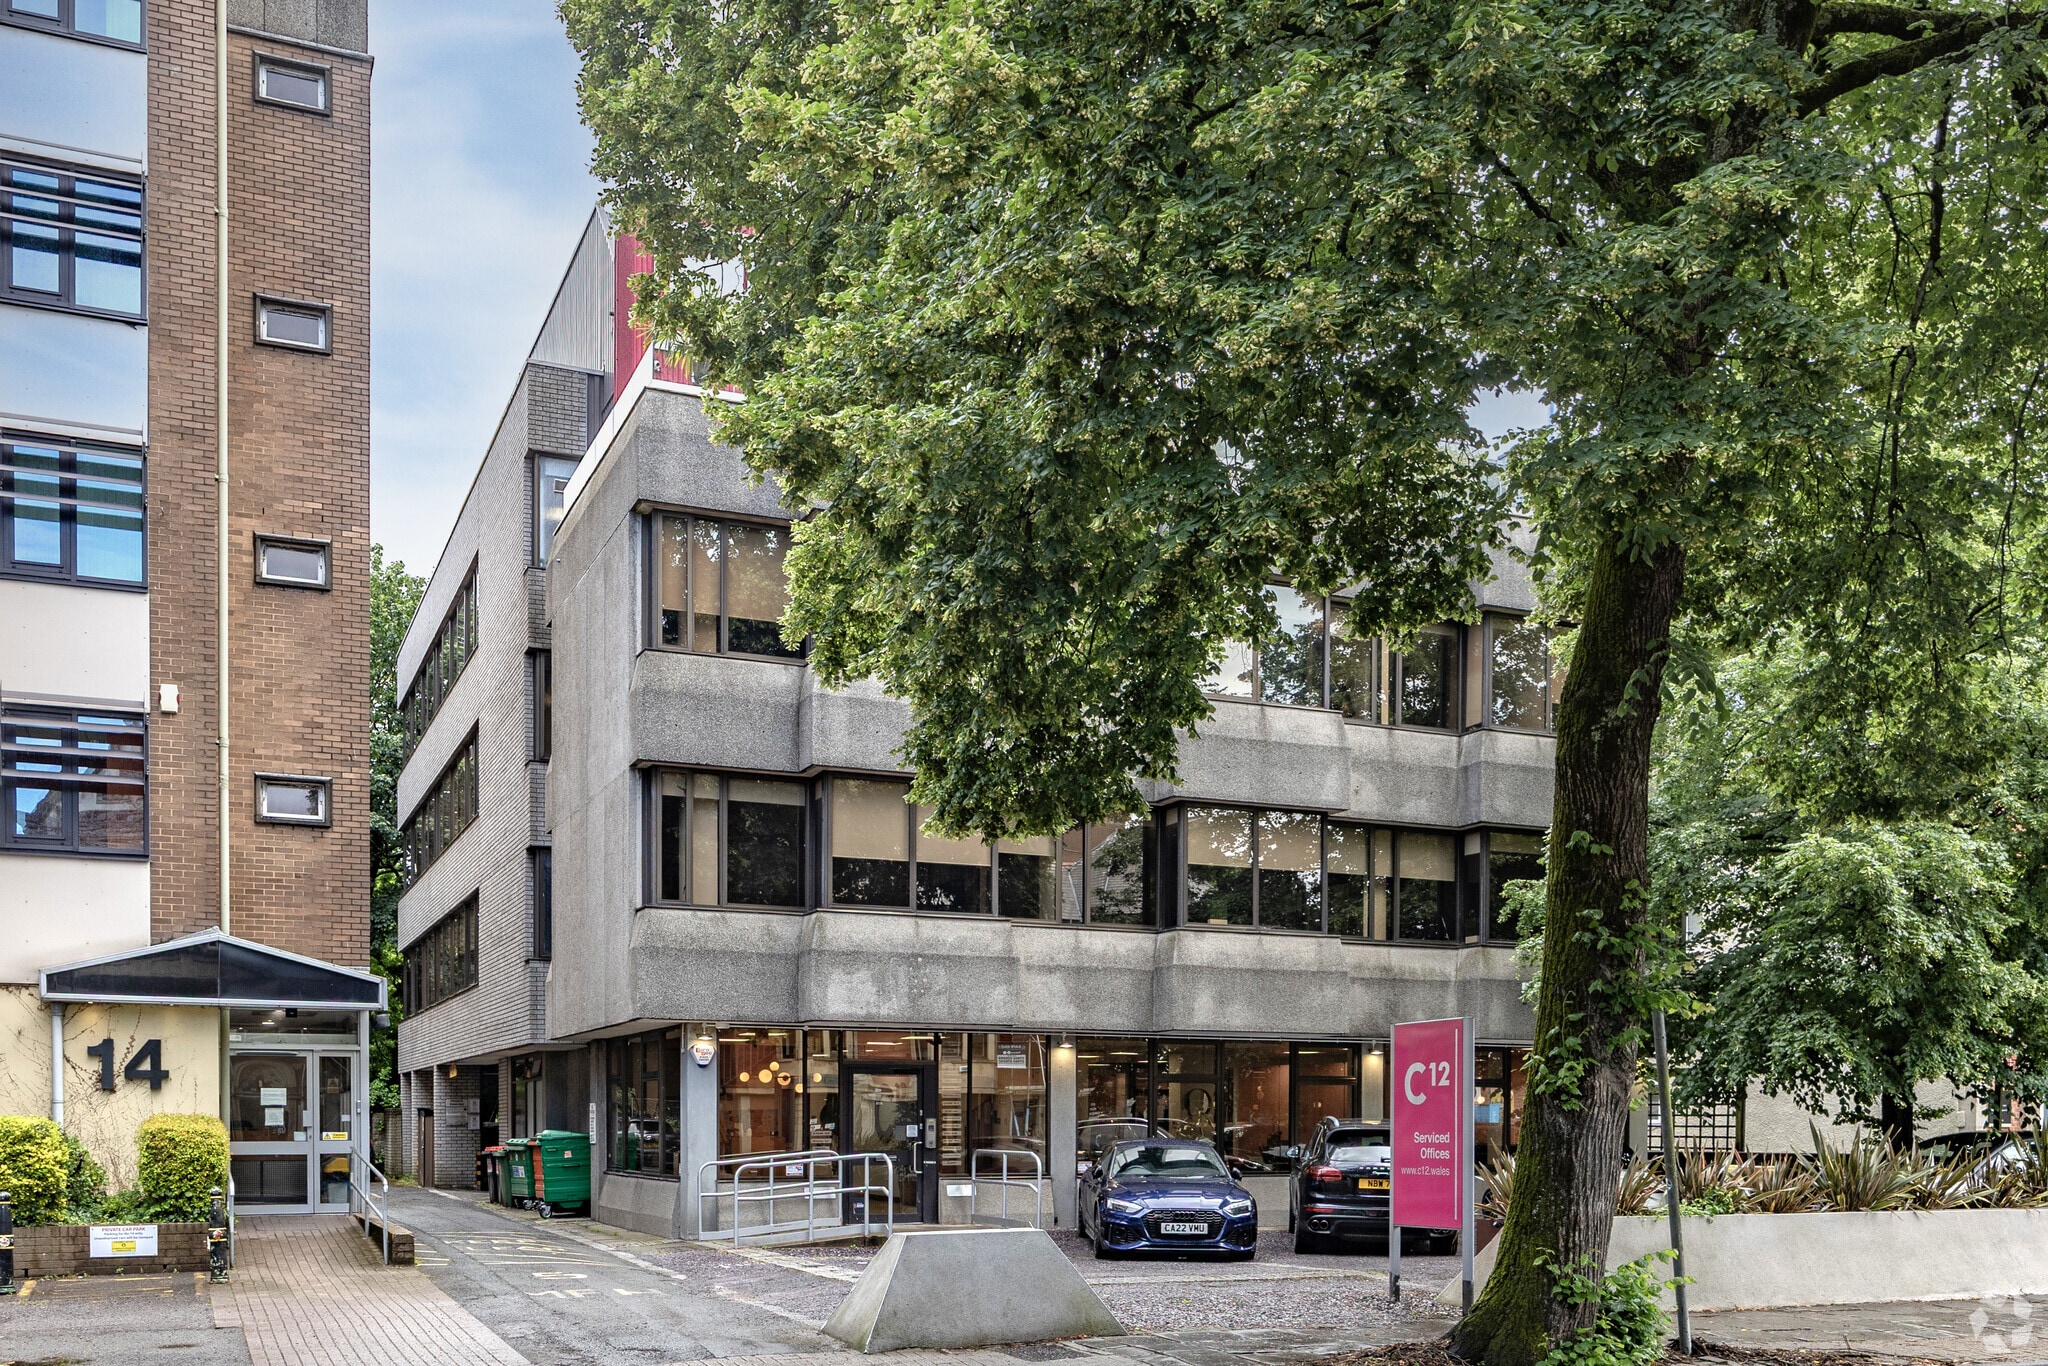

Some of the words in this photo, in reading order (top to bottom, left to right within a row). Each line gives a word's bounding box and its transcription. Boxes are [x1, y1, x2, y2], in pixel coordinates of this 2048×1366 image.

[87, 1039, 169, 1090] 14
[1413, 1132, 1450, 1144] Serviced
[1420, 1147, 1450, 1159] Offices
[1401, 1165, 1450, 1176] www.c12.wales
[1164, 1223, 1187, 1233] CA22
[1188, 1223, 1205, 1233] VMU
